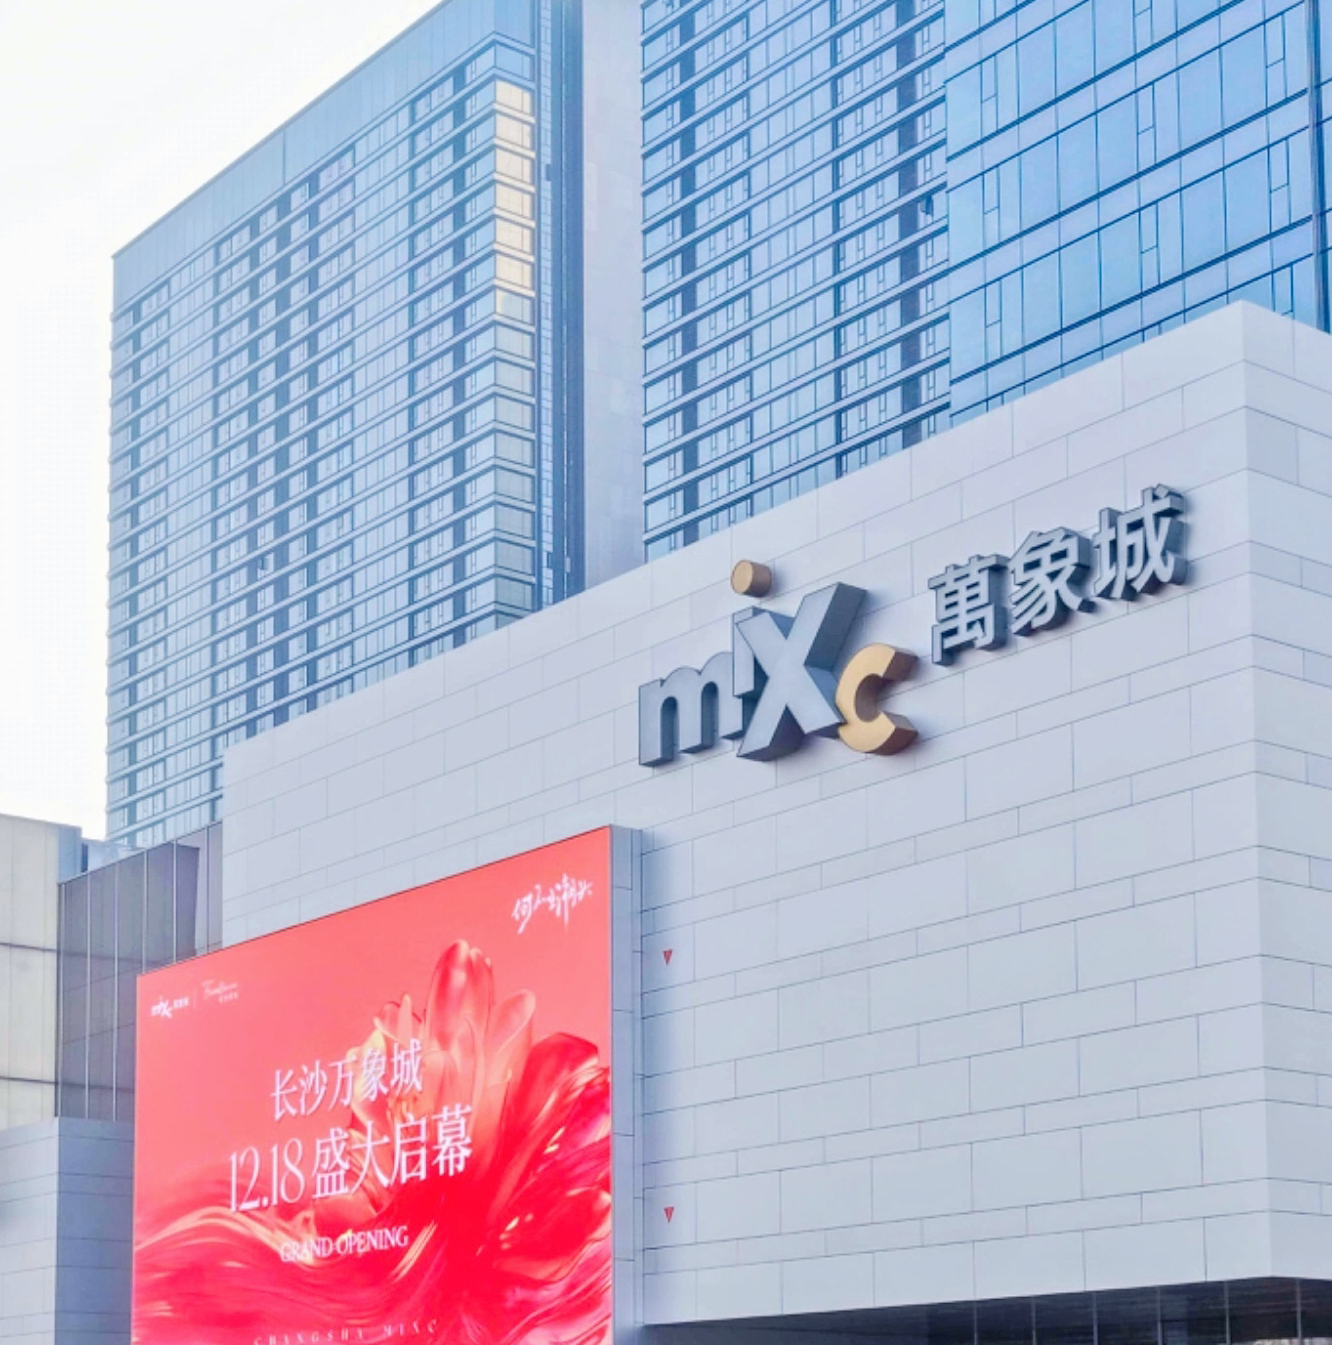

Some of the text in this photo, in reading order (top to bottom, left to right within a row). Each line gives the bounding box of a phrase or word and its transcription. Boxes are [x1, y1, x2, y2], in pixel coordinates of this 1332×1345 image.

[929, 484, 1191, 665] 萬象城
[270, 1038, 424, 1122] 长沙万象城
[229, 1103, 474, 1213] 12.18 盛大启幕
[279, 1225, 409, 1263] GRAND OPENING
